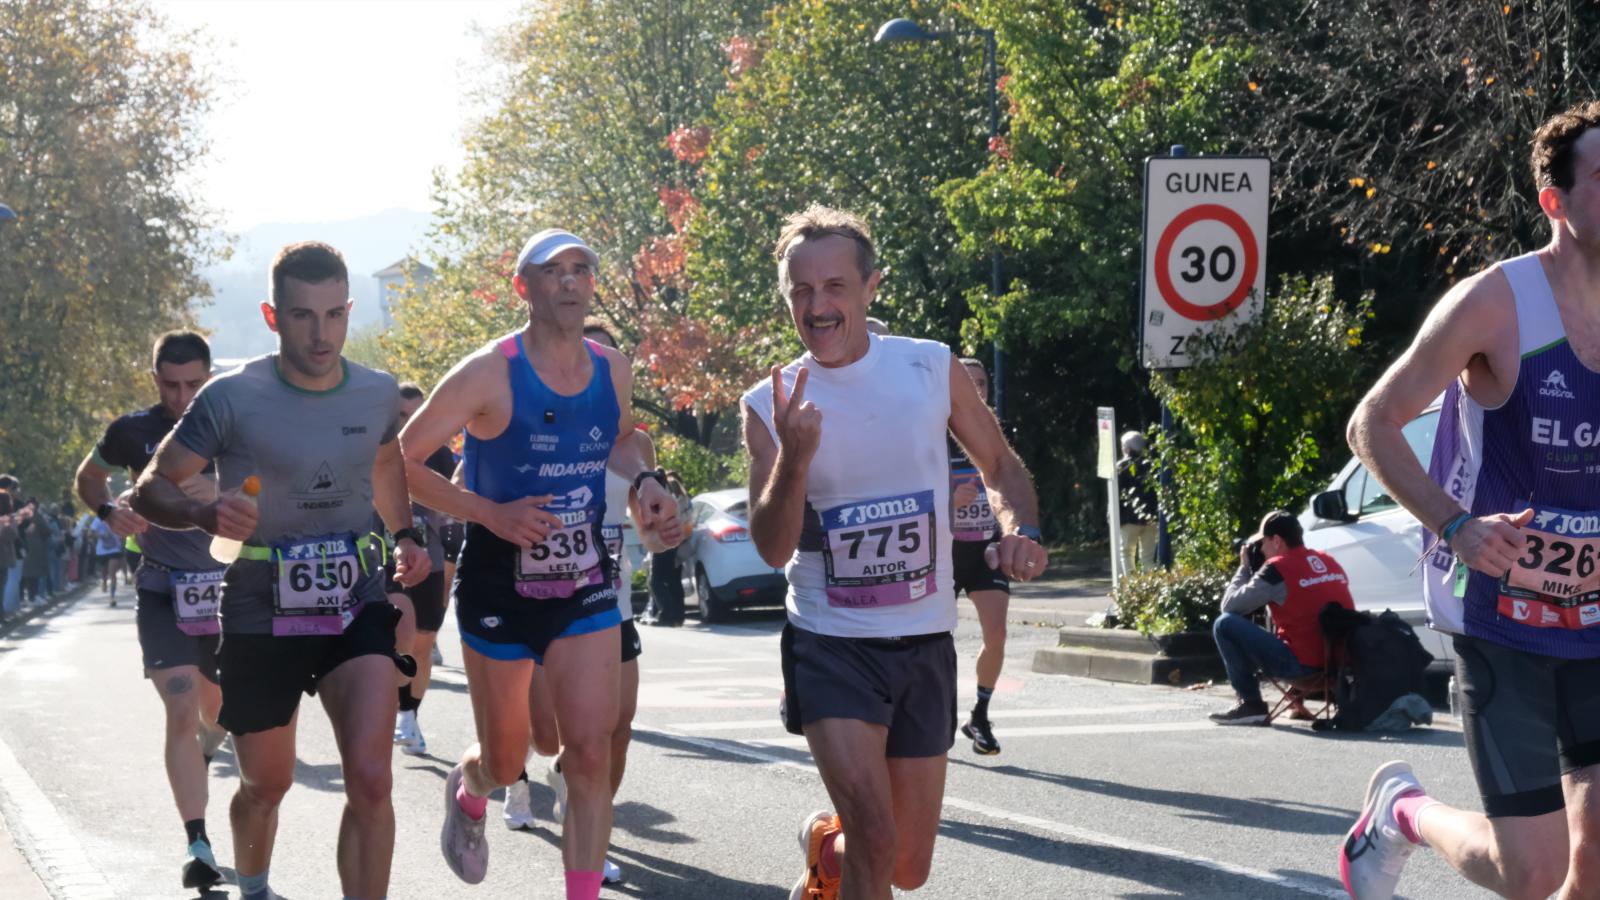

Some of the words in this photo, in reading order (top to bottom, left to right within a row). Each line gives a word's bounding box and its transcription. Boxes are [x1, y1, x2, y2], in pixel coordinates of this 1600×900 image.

[1165, 172, 1253, 194] GUNEA
[1180, 245, 1236, 283] 30
[1531, 416, 1569, 447] EL
[956, 503, 991, 520] 595
[529, 529, 588, 562] 538
[839, 520, 921, 561] 775
[548, 562, 580, 573] LETA
[862, 560, 907, 576] AITOR
[1517, 534, 1600, 579] 326
[289, 560, 353, 593] 650
[183, 584, 218, 606] 64
[316, 595, 339, 606] AXI
